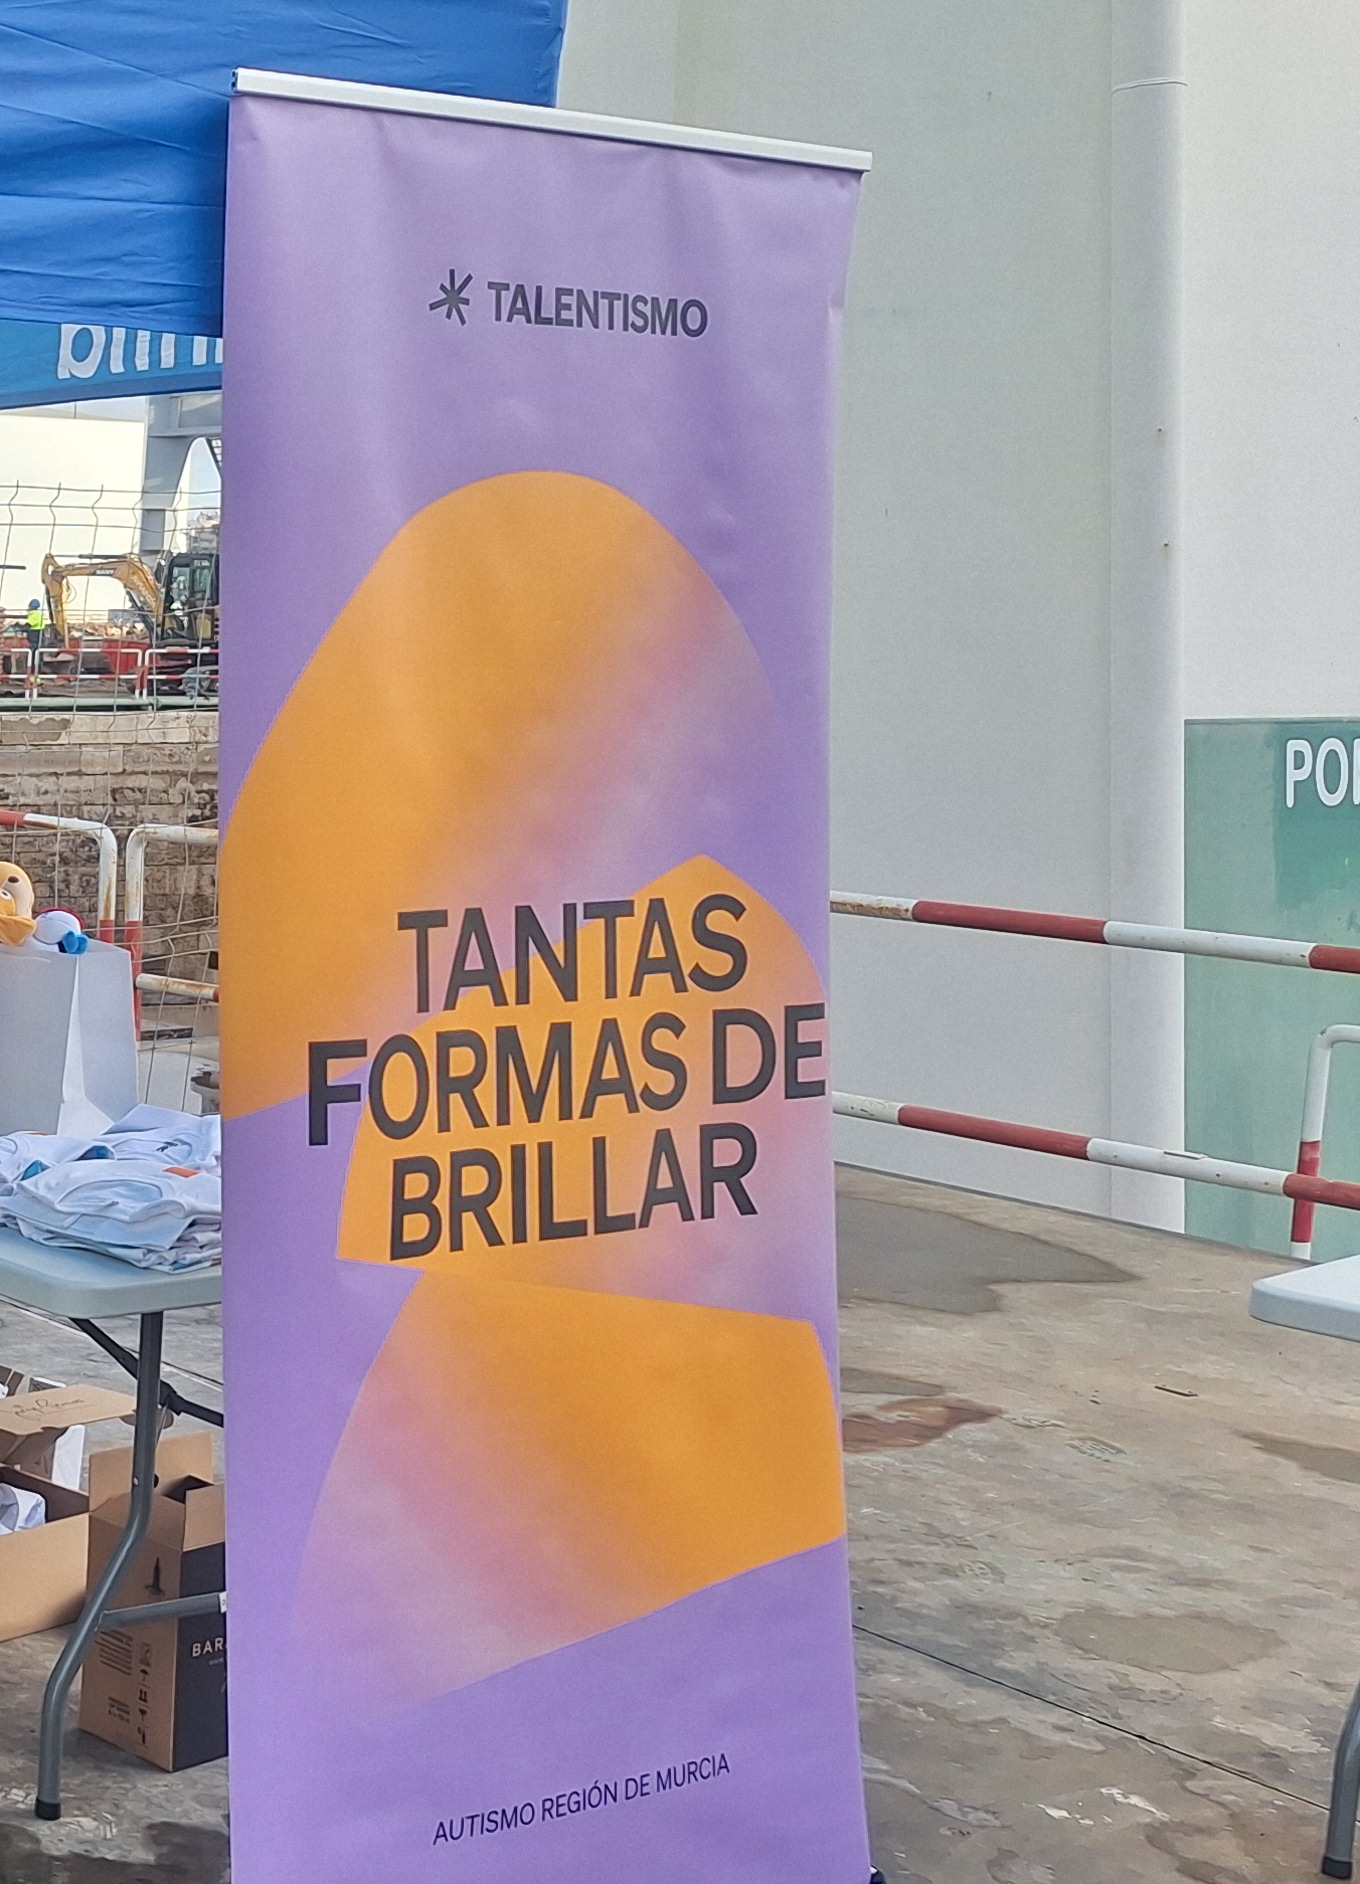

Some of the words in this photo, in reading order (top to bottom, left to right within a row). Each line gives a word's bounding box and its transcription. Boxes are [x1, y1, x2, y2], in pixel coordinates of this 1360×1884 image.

[487, 281, 708, 338] TALENTISMO
[397, 893, 747, 1013] TANTAS
[308, 1012, 688, 1146] FORMAS
[712, 1003, 826, 1105] DE
[389, 1122, 758, 1261] BRILLAR
[432, 1802, 536, 1846] AUTISMO
[541, 1780, 618, 1822] REGIÓN
[624, 1773, 651, 1801] DE
[656, 1752, 730, 1793] MURCIA
